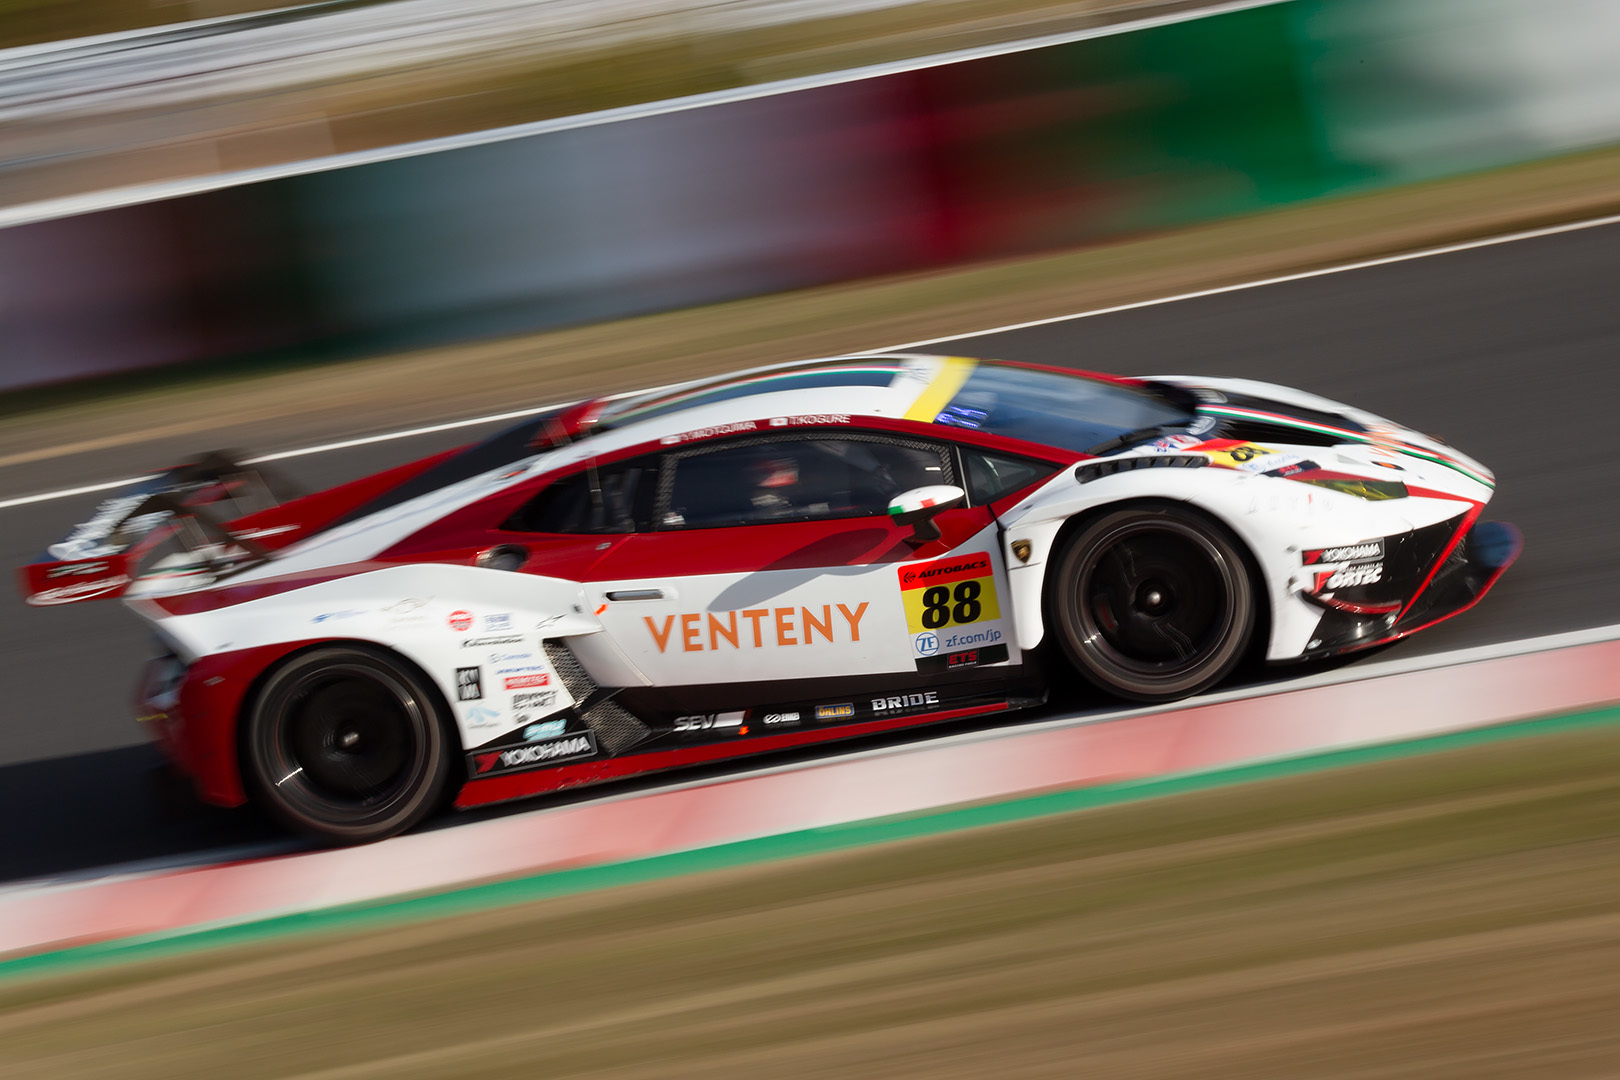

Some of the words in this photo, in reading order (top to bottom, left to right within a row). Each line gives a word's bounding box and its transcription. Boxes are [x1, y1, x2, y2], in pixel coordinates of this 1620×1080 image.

[1321, 543, 1380, 562] YOKOHAMA
[918, 560, 987, 579] AUTOBACS
[921, 580, 982, 630] 88
[643, 601, 870, 653] VENTENY
[945, 629, 1002, 648] zf.com/jp
[948, 650, 978, 665] ETS
[871, 691, 940, 711] BRIDE
[672, 713, 715, 732] SEV
[500, 735, 592, 767] YOKOHAMA
